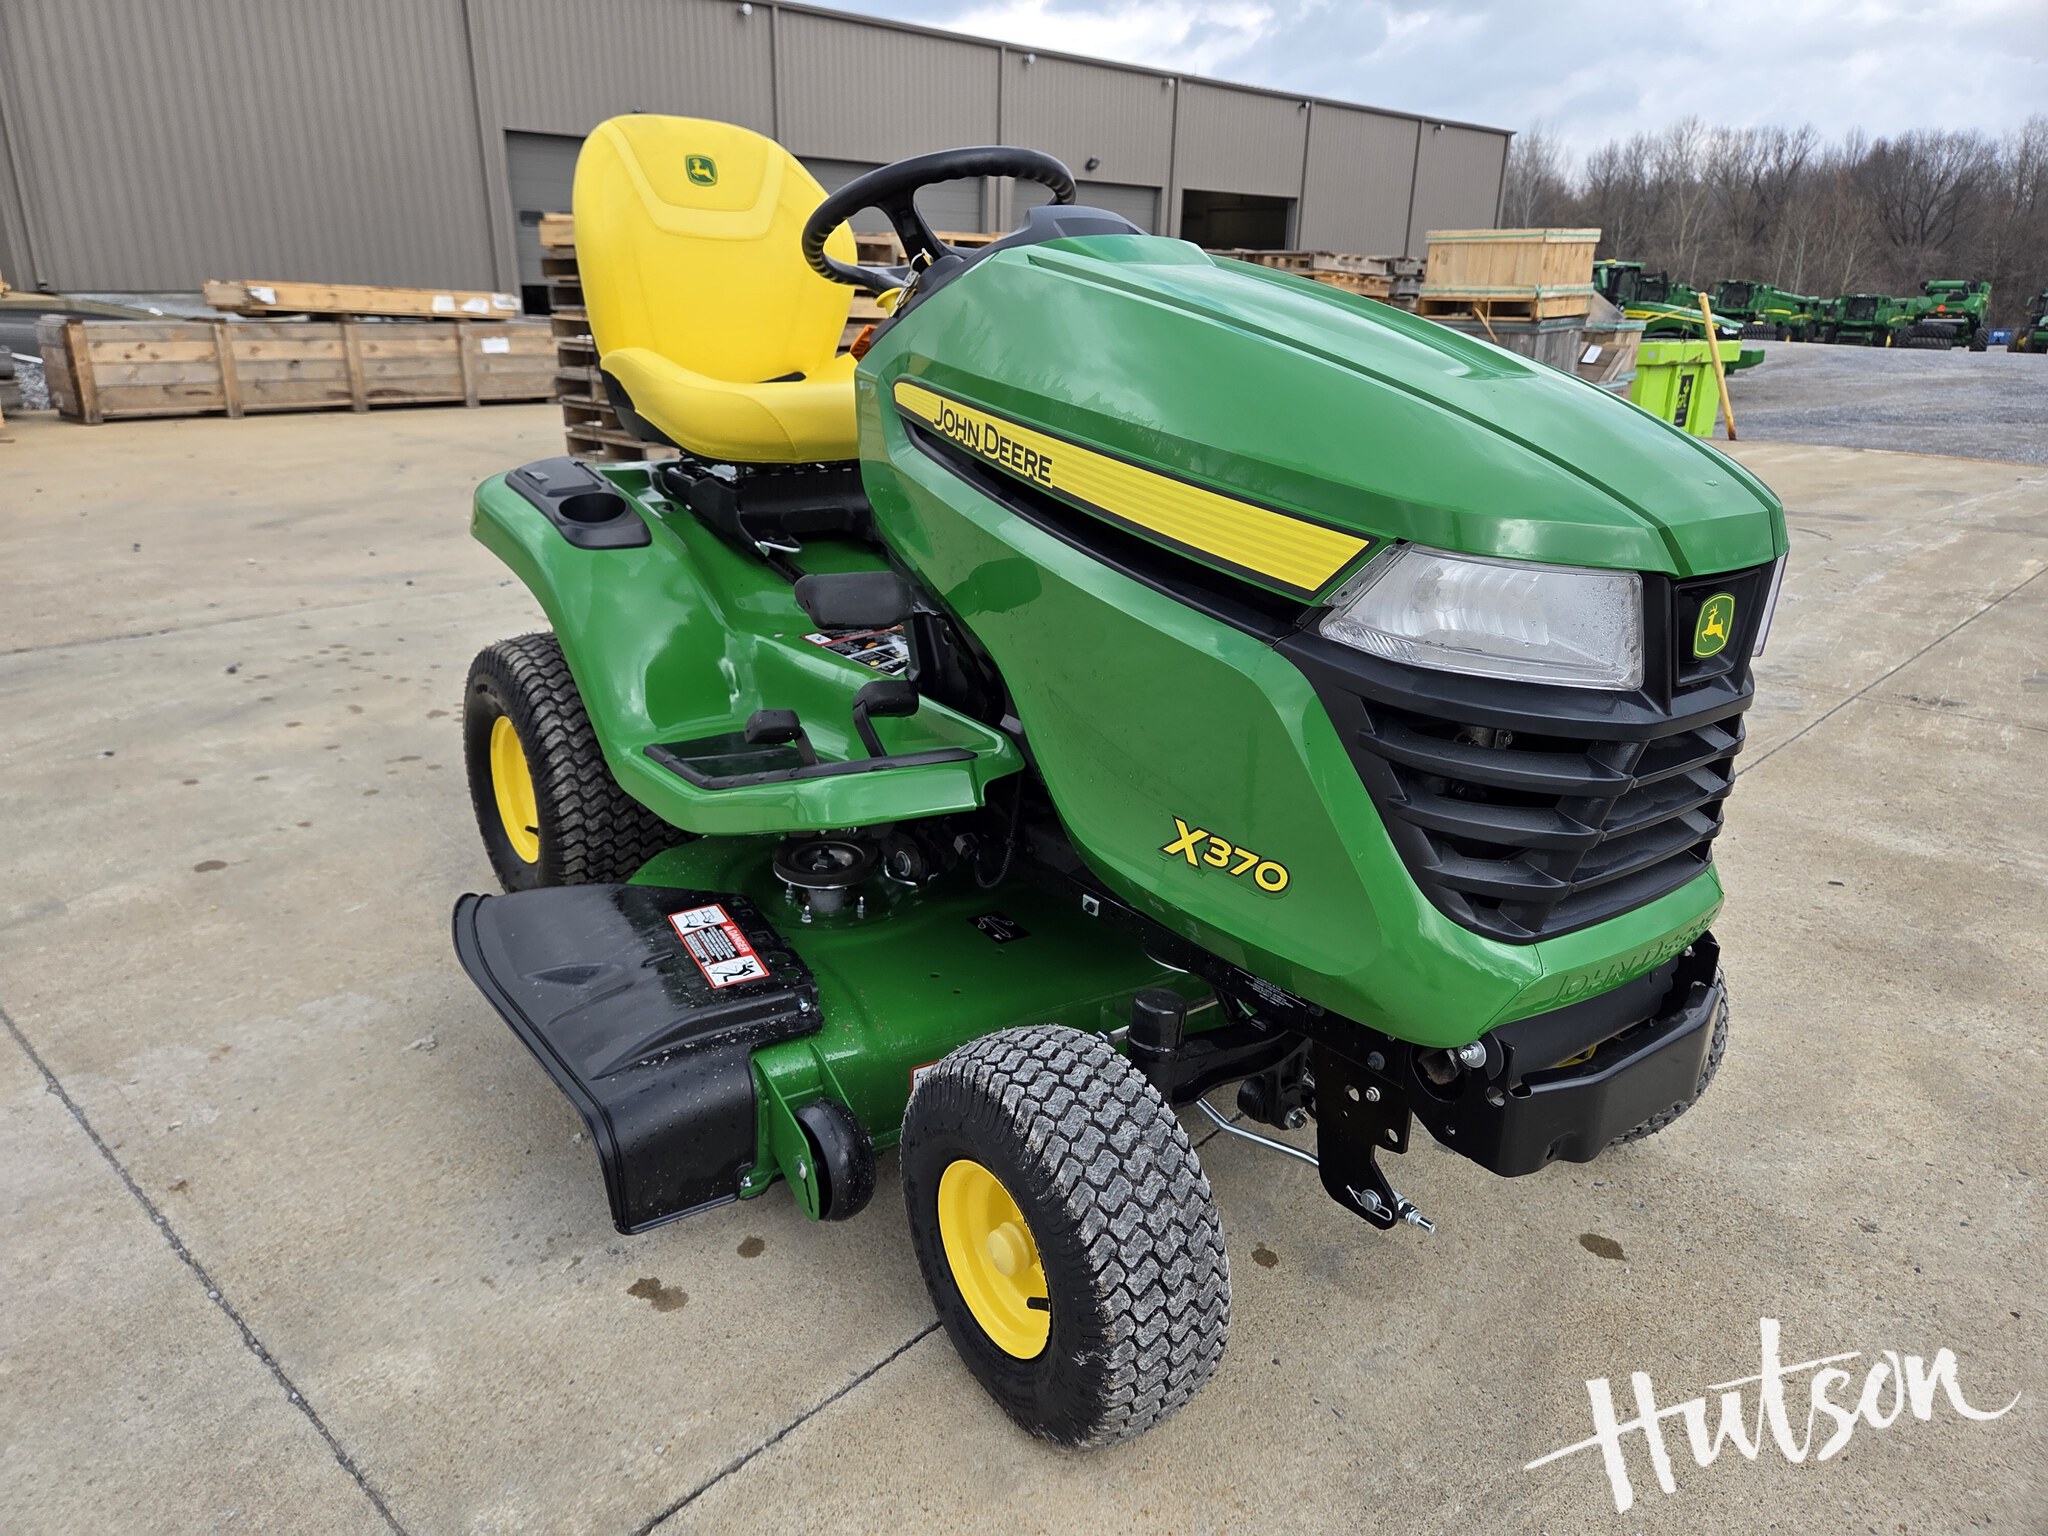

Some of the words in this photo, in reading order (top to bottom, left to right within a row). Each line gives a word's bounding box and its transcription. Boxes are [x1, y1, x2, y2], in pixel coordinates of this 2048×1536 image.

[933, 399, 980, 450] JOHN
[983, 422, 1053, 486] DEERE
[1158, 815, 1291, 894] X370
[727, 929, 751, 953] DANGER
